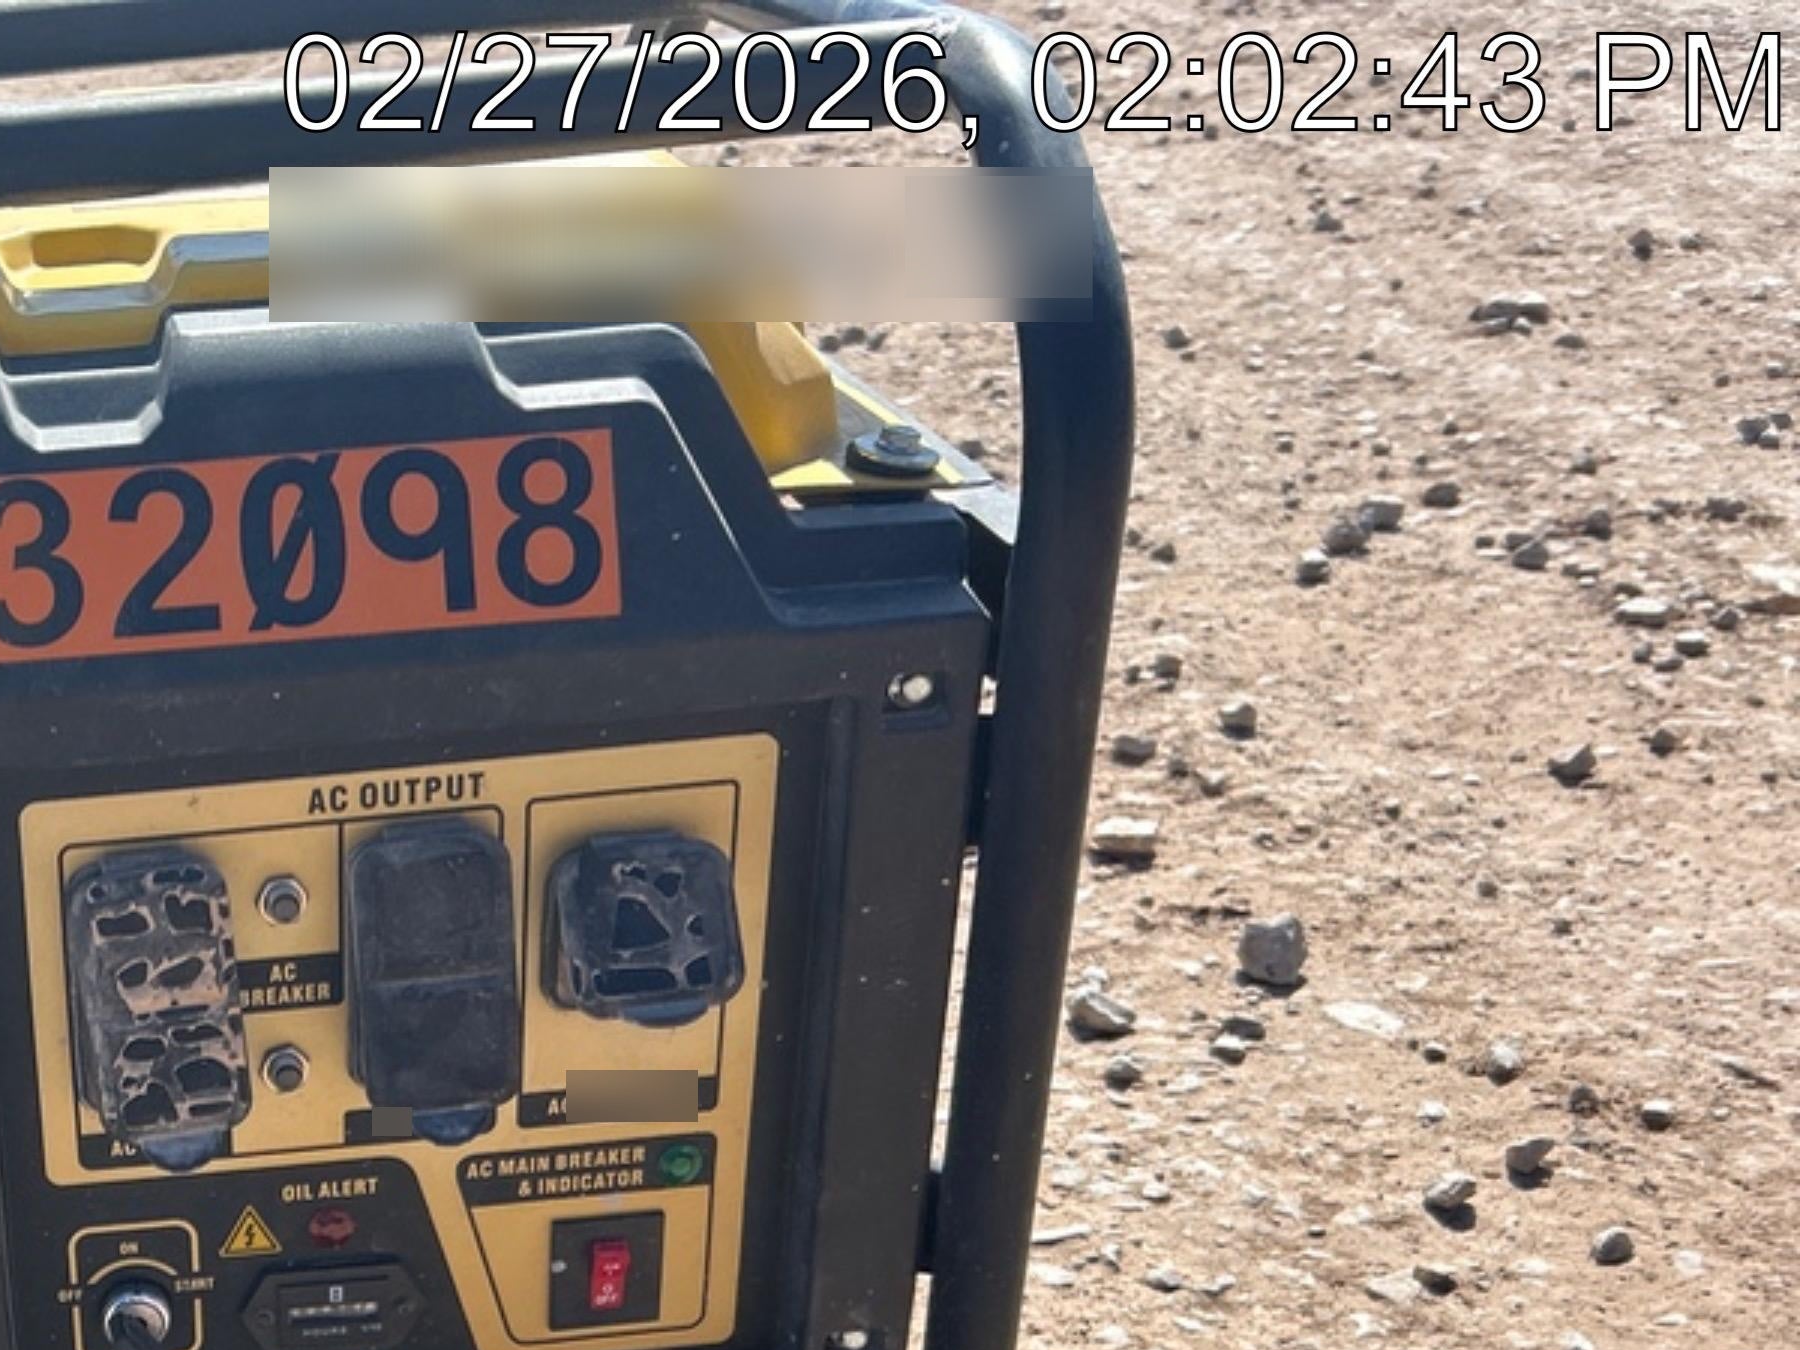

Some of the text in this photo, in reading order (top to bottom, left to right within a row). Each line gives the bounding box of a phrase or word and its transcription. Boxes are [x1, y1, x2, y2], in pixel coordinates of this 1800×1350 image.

[308, 771, 484, 815] AC OUTPUT
[269, 961, 297, 983] AC
[240, 982, 332, 1008] BREAKER
[466, 1145, 646, 1181] AC MAIN BREAKER
[281, 1177, 379, 1203] OIL ALERT
[518, 1169, 644, 1198] & INDICATOR
[119, 1242, 140, 1256] ON
[56, 1288, 83, 1304] OFF
[174, 1277, 215, 1293] START
